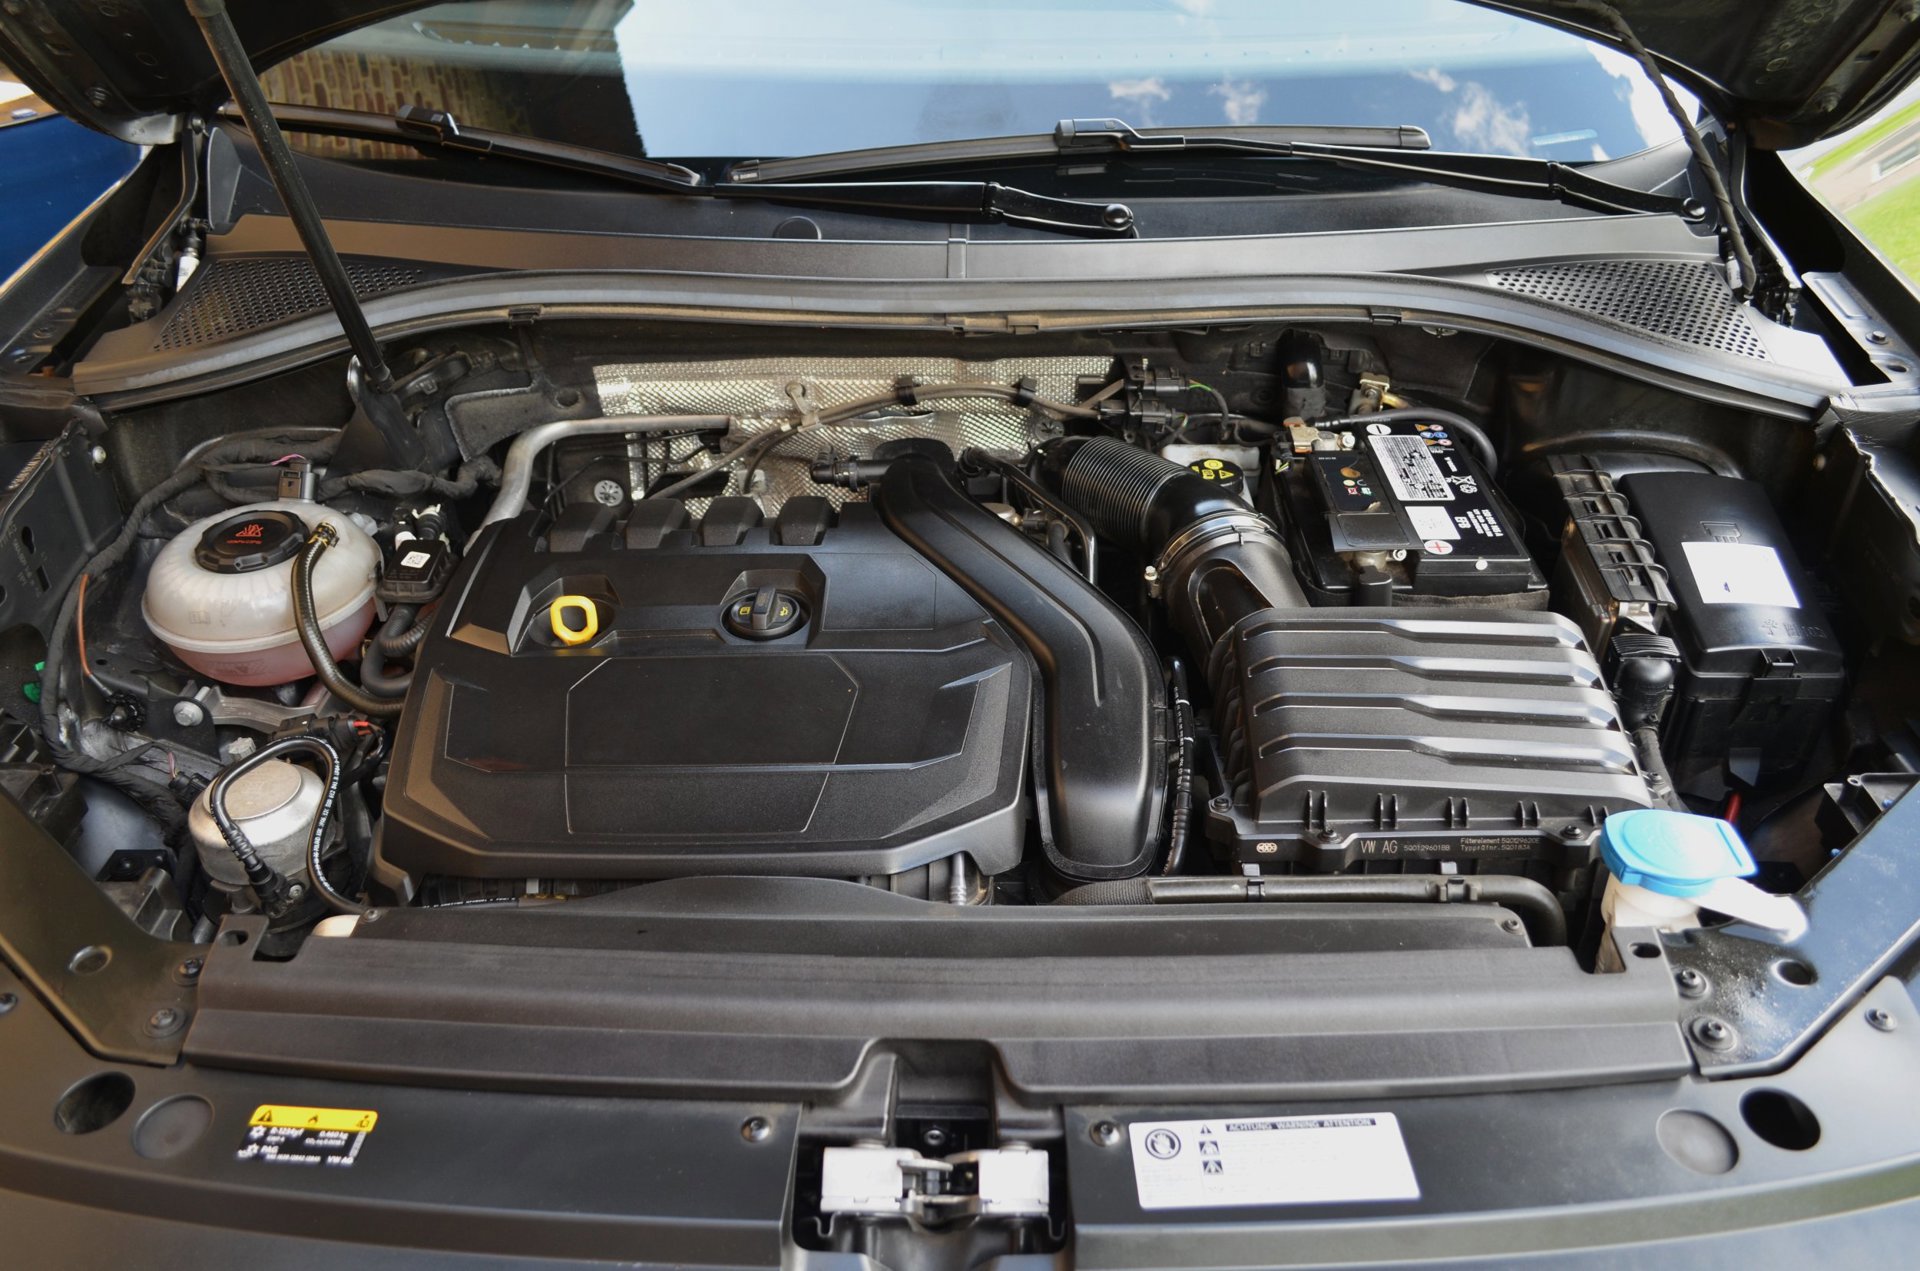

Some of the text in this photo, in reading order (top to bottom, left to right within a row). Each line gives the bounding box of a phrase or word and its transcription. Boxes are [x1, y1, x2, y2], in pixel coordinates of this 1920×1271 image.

[1360, 839, 1398, 854] VW AG
[1229, 1118, 1370, 1131] ACHTUNG WARNING ATTENTION
